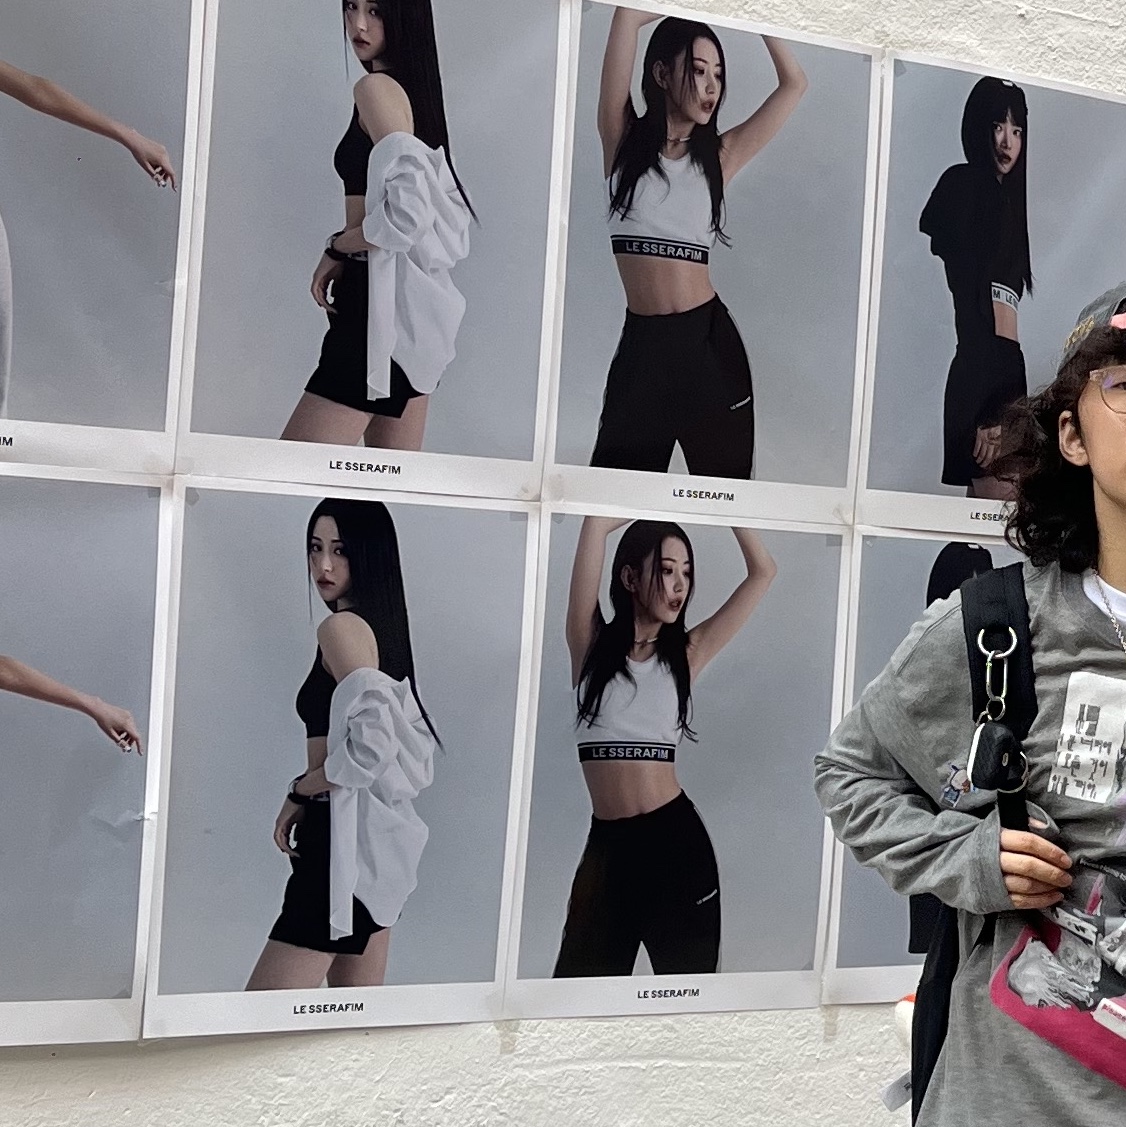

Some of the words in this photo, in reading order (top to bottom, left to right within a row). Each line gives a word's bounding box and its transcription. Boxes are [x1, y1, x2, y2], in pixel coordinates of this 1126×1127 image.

[626, 241, 640, 254] LE
[642, 243, 703, 262] SSERAFIM
[329, 460, 343, 471] LE
[345, 461, 401, 475] SSERAFIM
[672, 488, 685, 498] LE
[686, 489, 735, 502] SSERAFIM
[970, 511, 980, 520] LE
[982, 512, 1009, 521] SSERA
[591, 748, 607, 759] LE
[608, 747, 669, 760] SSERAFIM
[638, 990, 650, 999] LE
[651, 988, 700, 999] SSERAFIM
[294, 1004, 307, 1015] LE
[309, 1002, 364, 1014] SSERAFIM
